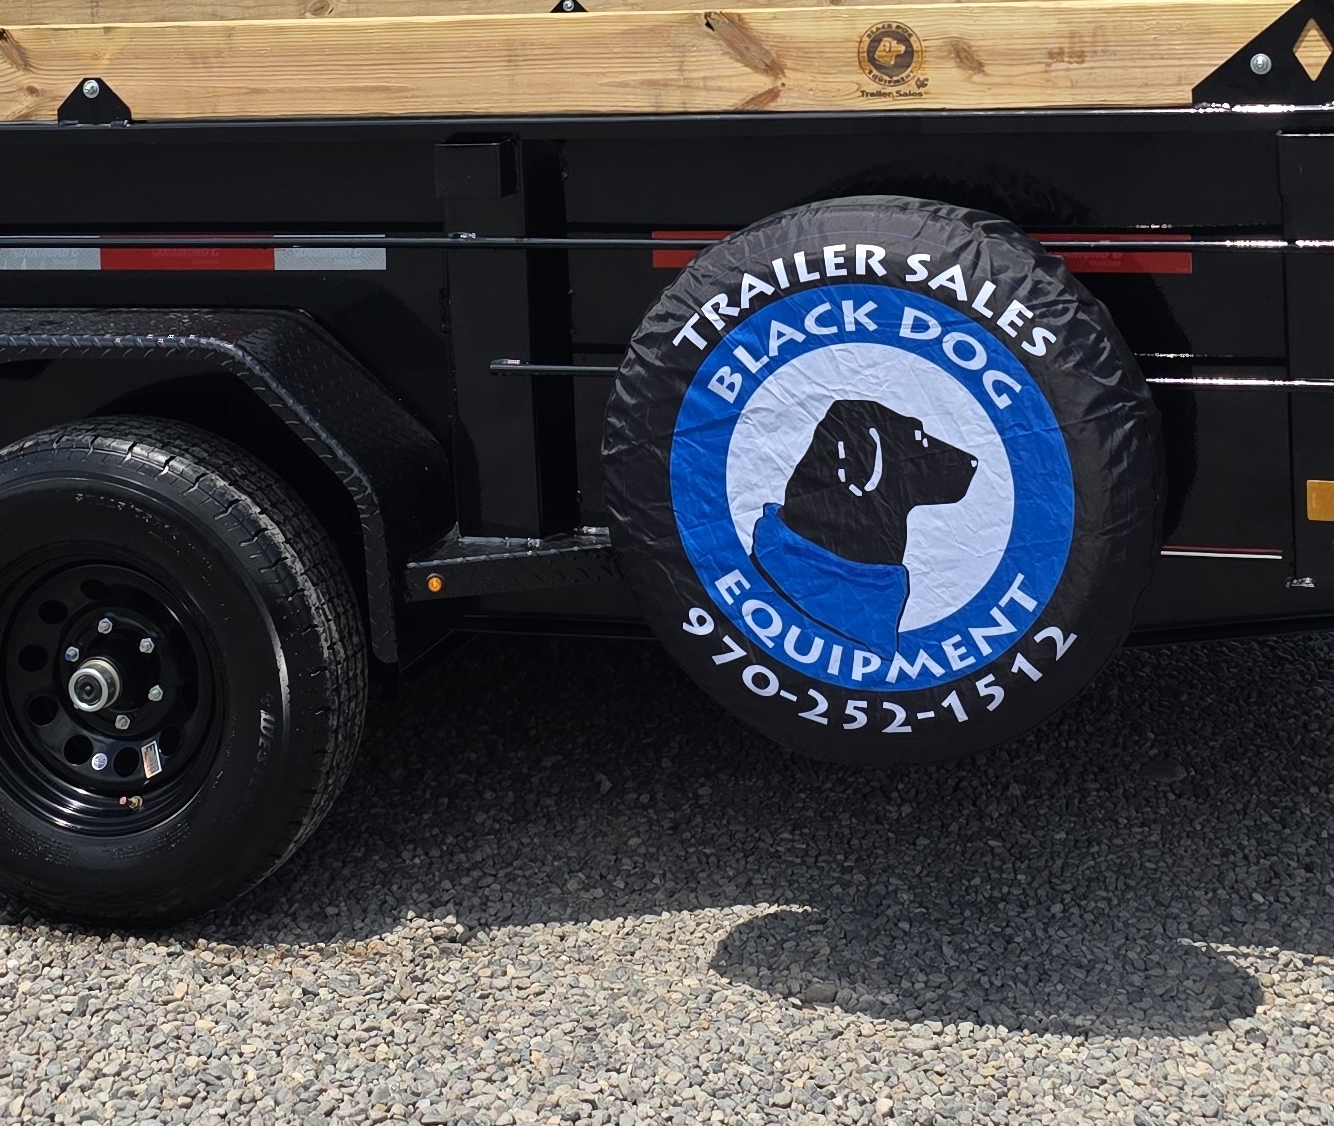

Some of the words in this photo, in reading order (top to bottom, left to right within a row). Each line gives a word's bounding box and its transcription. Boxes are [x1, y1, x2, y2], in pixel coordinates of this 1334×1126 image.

[860, 89, 894, 98] Trailer
[672, 243, 886, 352] TRAILER
[905, 253, 1058, 357] SALES
[706, 299, 879, 404] BLACK
[898, 307, 1022, 411] DOG
[682, 606, 1078, 734] 970-252-1512
[713, 568, 1038, 684] EQUIPMENT
